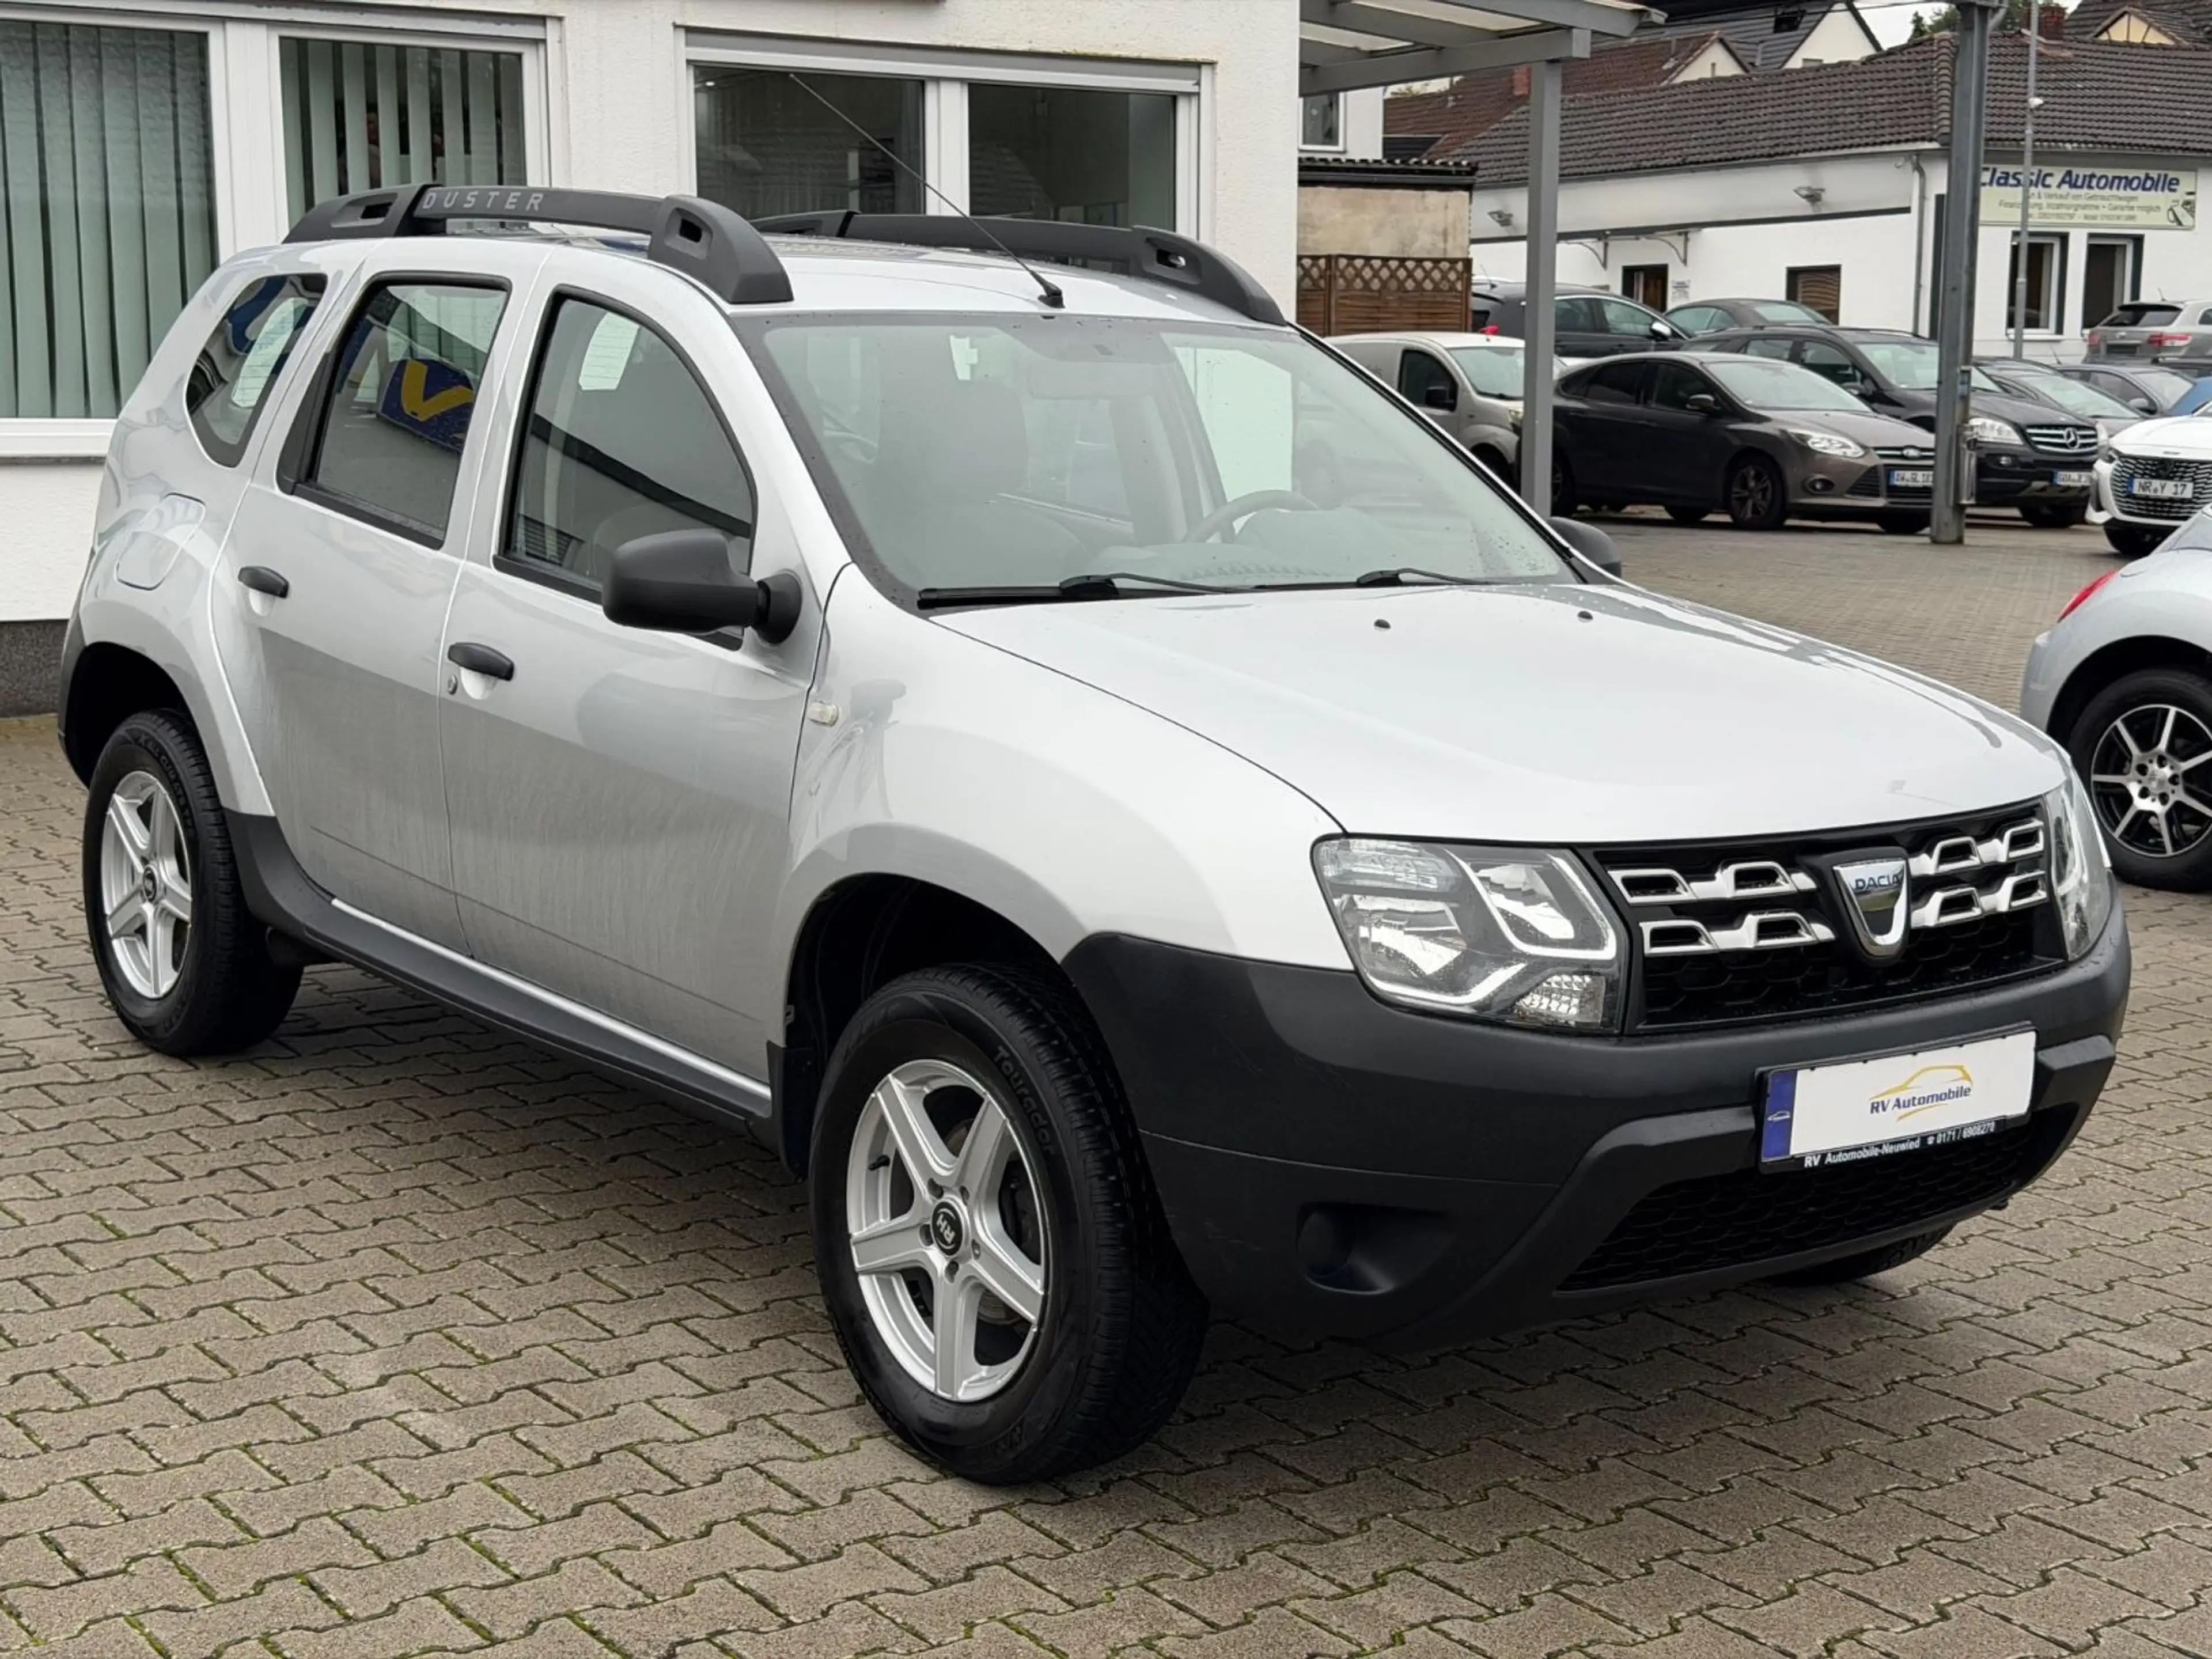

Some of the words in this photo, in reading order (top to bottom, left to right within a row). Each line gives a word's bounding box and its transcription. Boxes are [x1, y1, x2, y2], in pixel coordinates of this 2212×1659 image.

[2056, 169, 2180, 192] Automobile
[422, 191, 543, 211] DUSTER
[1854, 874, 1901, 891] DACIA
[993, 1046, 1056, 1154] Tourador
[1870, 1099, 1891, 1115] RV
[1891, 1085, 1972, 1111] Automobile
[1804, 1154, 1821, 1168] RV
